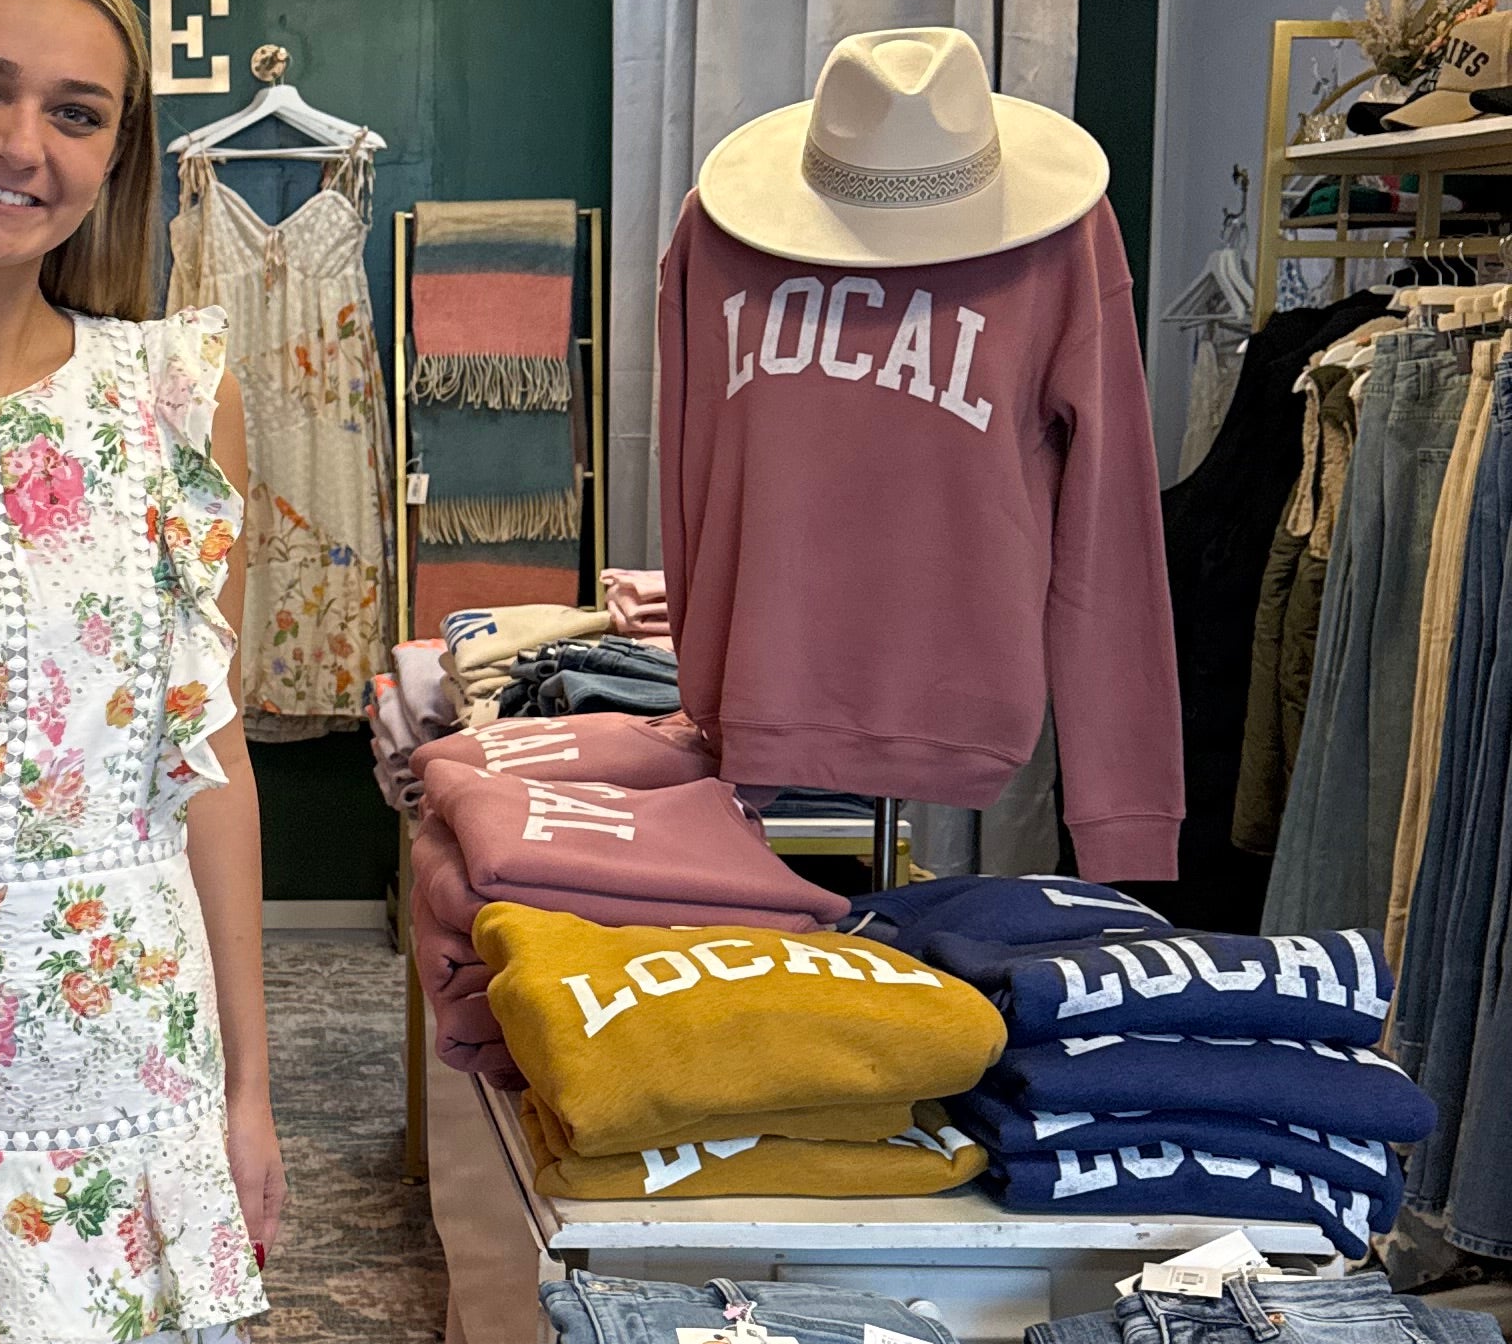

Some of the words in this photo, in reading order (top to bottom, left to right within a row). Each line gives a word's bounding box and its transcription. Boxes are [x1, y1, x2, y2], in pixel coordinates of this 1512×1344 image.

[722, 275, 993, 434] LOCAL
[560, 936, 944, 1039] LOCAL
[1040, 927, 1392, 1021] LOCAL
